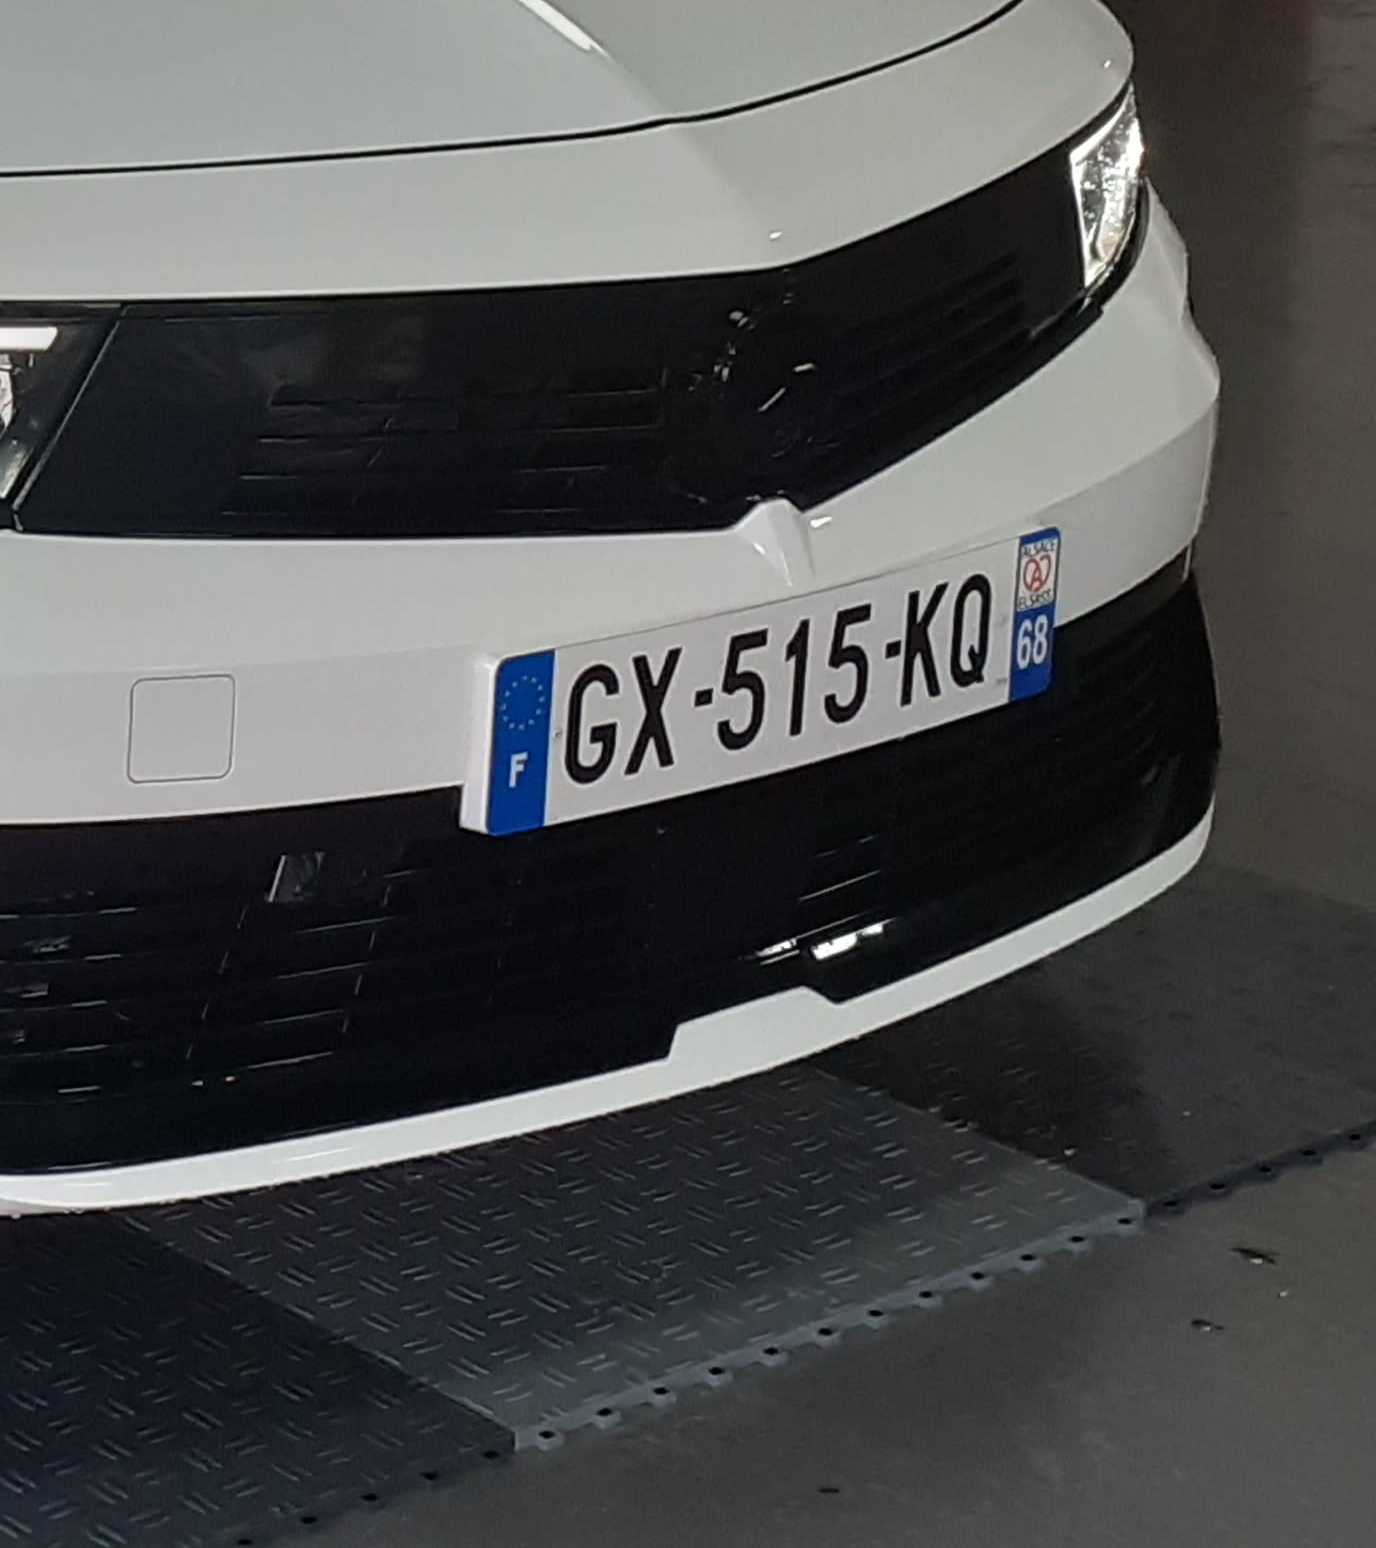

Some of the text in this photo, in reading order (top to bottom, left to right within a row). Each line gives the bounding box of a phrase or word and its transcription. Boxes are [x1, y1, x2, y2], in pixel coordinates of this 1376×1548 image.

[1021, 540, 1055, 557] ALSACE
[1016, 614, 1049, 670] 68
[565, 574, 993, 785] GX-515-KQ
[508, 751, 528, 788] F
